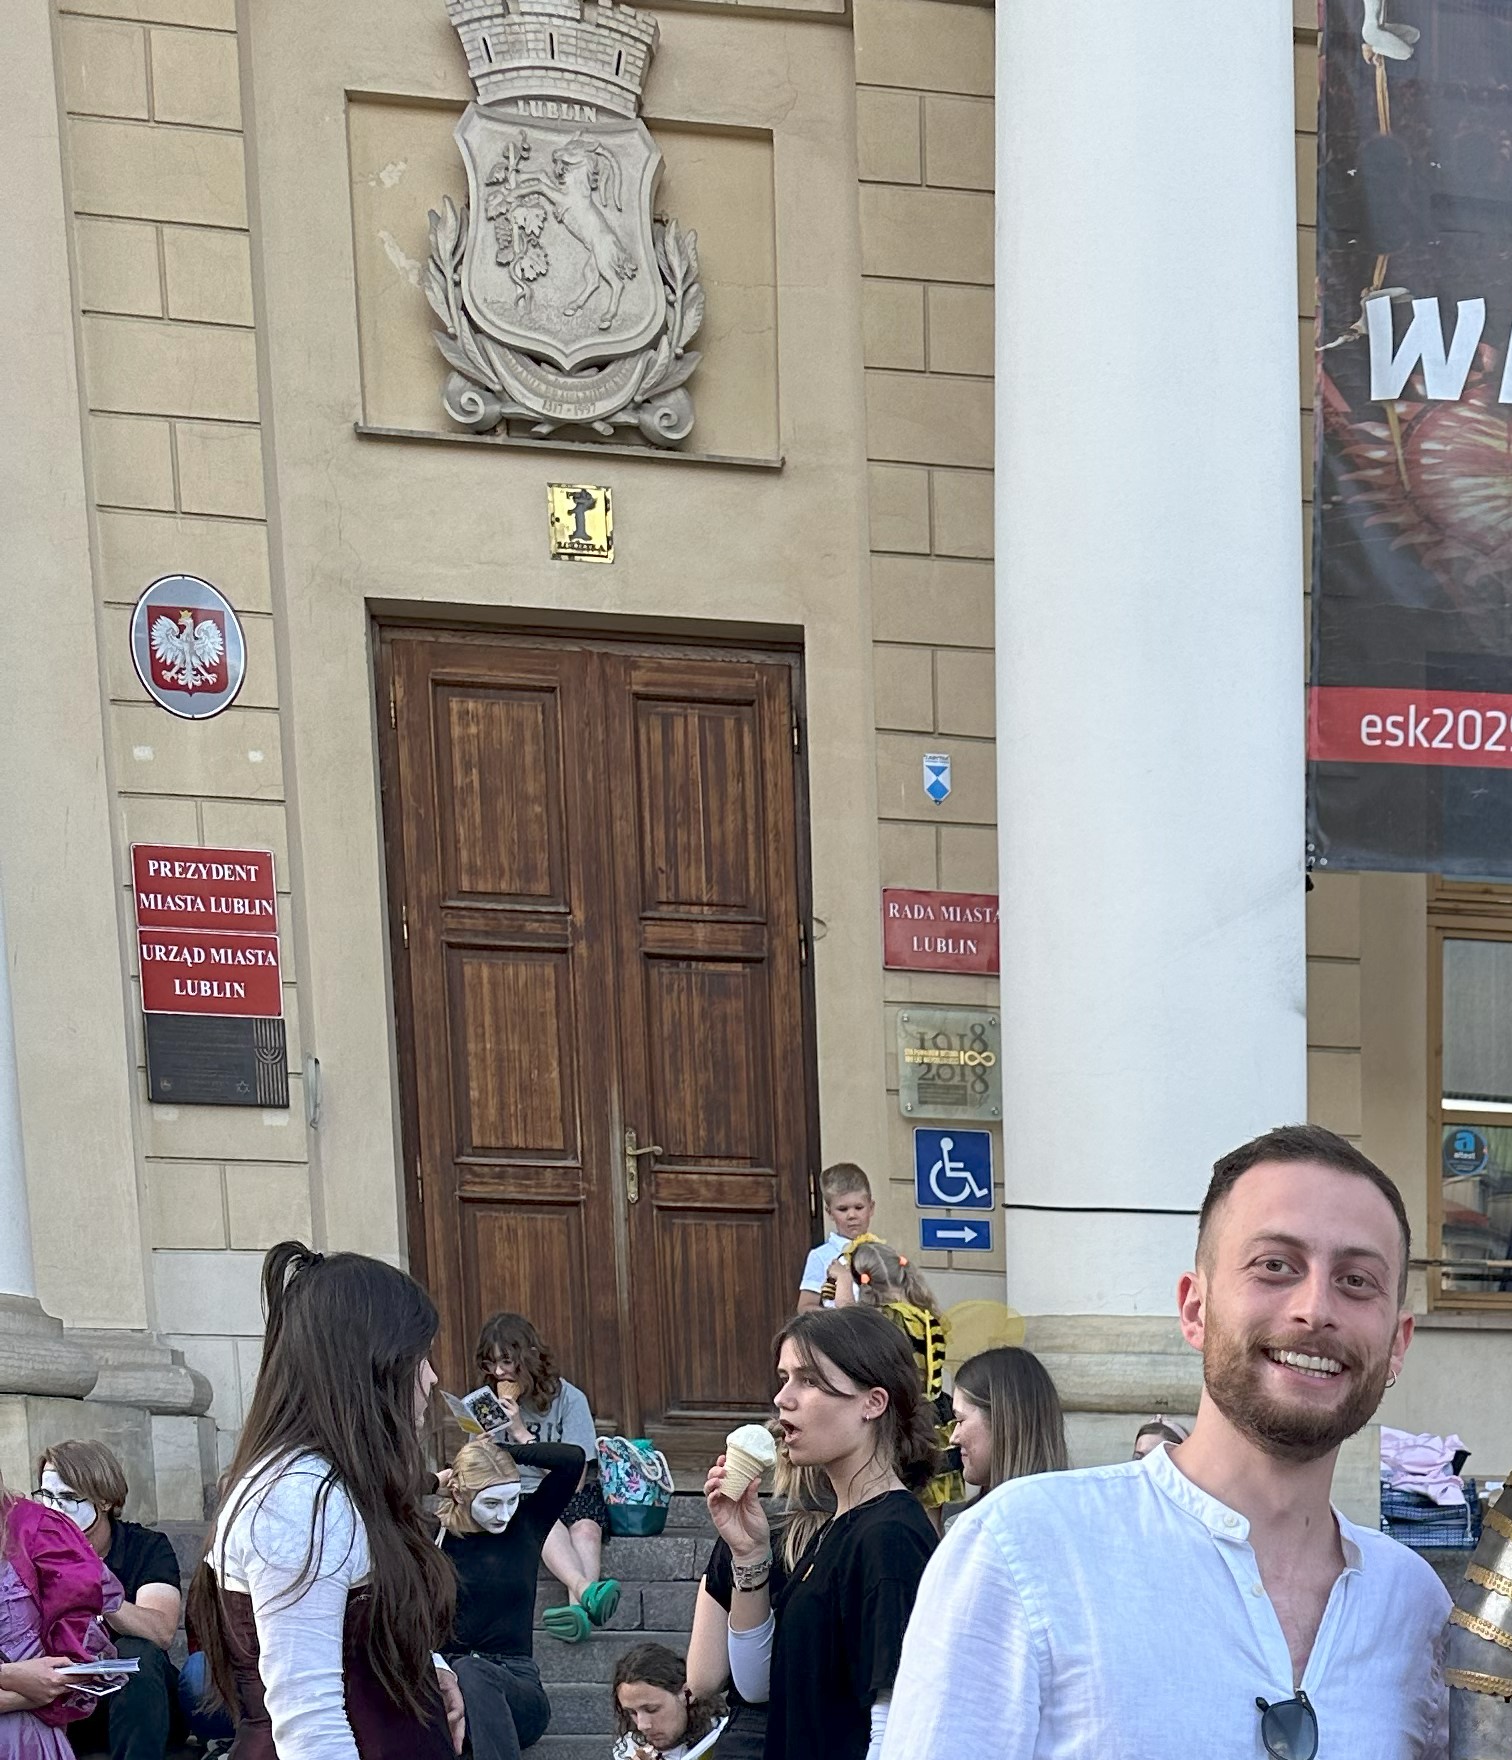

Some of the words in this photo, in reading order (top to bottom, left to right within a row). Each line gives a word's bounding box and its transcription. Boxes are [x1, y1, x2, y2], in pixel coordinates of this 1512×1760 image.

[517, 99, 597, 123] LUBLIN
[1365, 297, 1485, 402] w
[148, 860, 259, 882] PREZYDENT
[139, 893, 205, 912] MIASTA
[210, 897, 274, 916] LUBLIN
[889, 902, 935, 920] RADA
[141, 944, 206, 967] URZĄD
[210, 948, 278, 966] MIASTA
[913, 936, 977, 955] LUBLIN
[173, 979, 245, 999] LUBLIN
